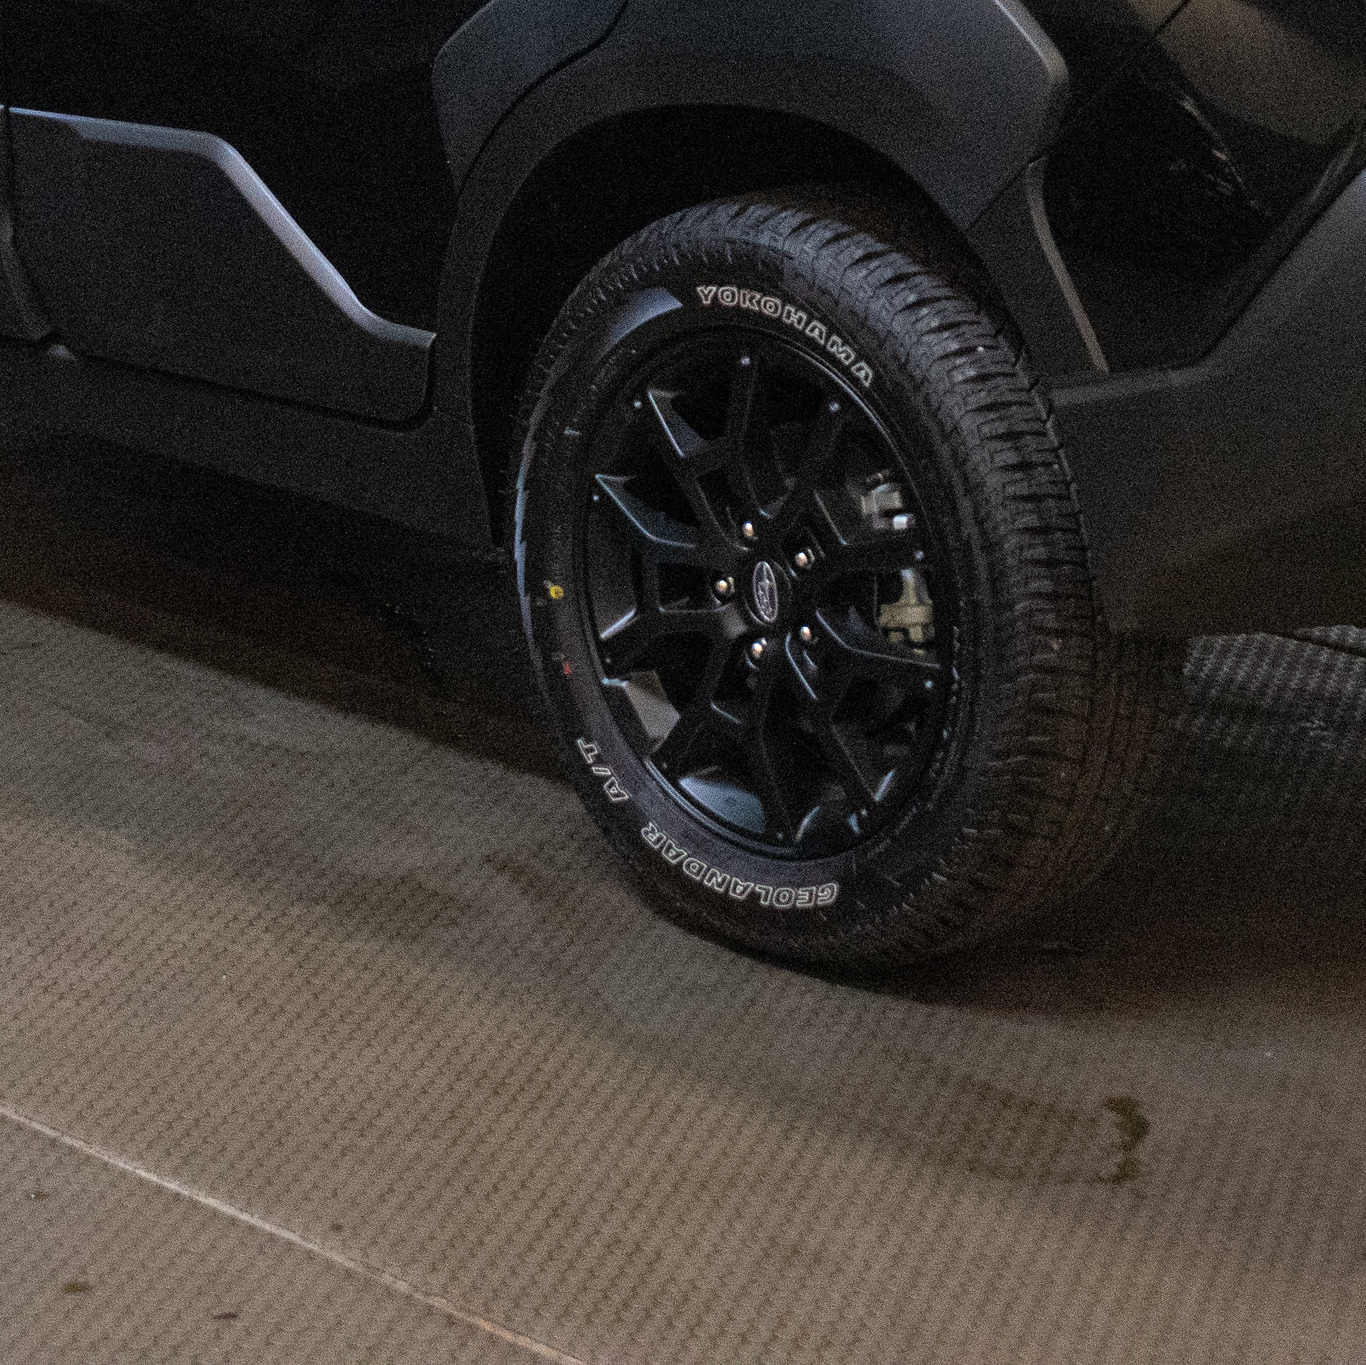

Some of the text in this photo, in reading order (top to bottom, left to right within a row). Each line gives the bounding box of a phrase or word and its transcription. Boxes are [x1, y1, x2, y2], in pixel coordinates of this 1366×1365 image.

[696, 284, 875, 388] YOKOHAMA
[576, 735, 632, 805] A/T
[640, 820, 840, 910] GEOLANDAR
